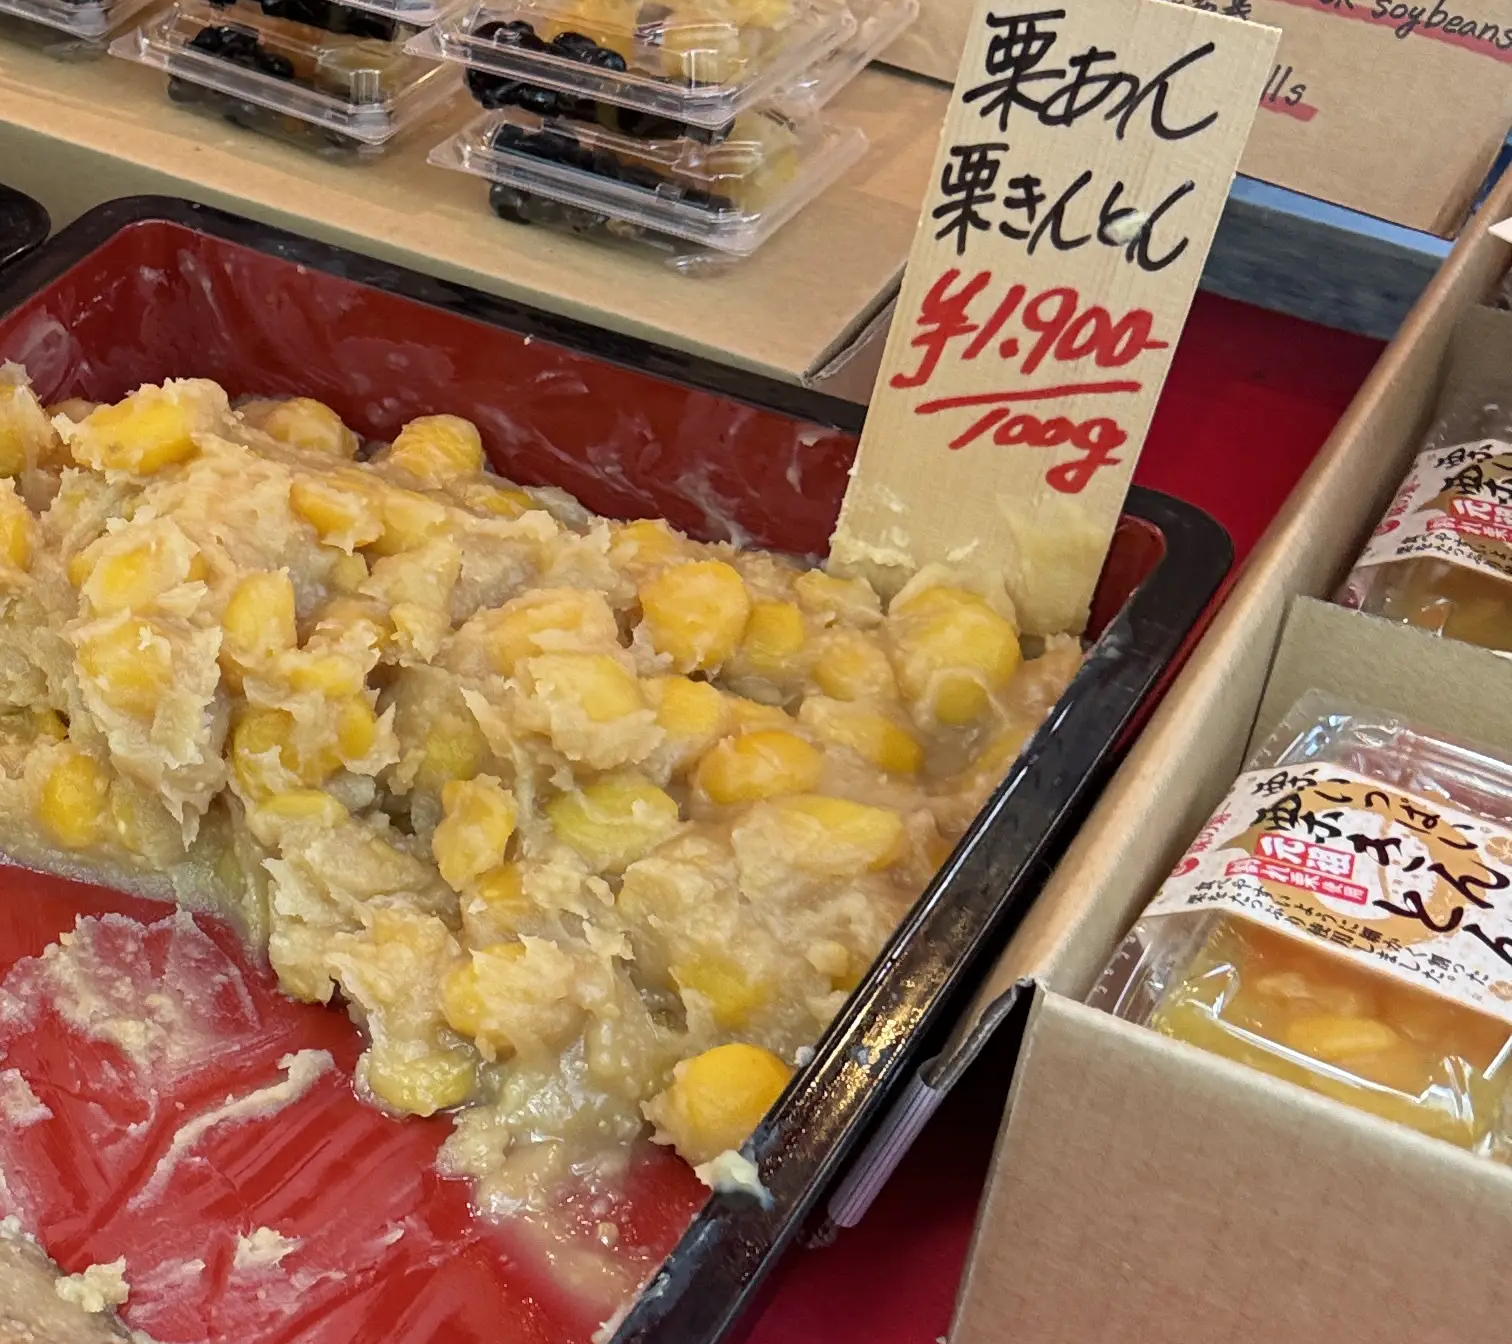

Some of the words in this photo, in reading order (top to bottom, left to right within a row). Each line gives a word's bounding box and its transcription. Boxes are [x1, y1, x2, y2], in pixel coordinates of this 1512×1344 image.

[961, 8, 1220, 141] 栗あん
[1261, 63, 1308, 106] lls
[931, 142, 1195, 272] 栗きんとん
